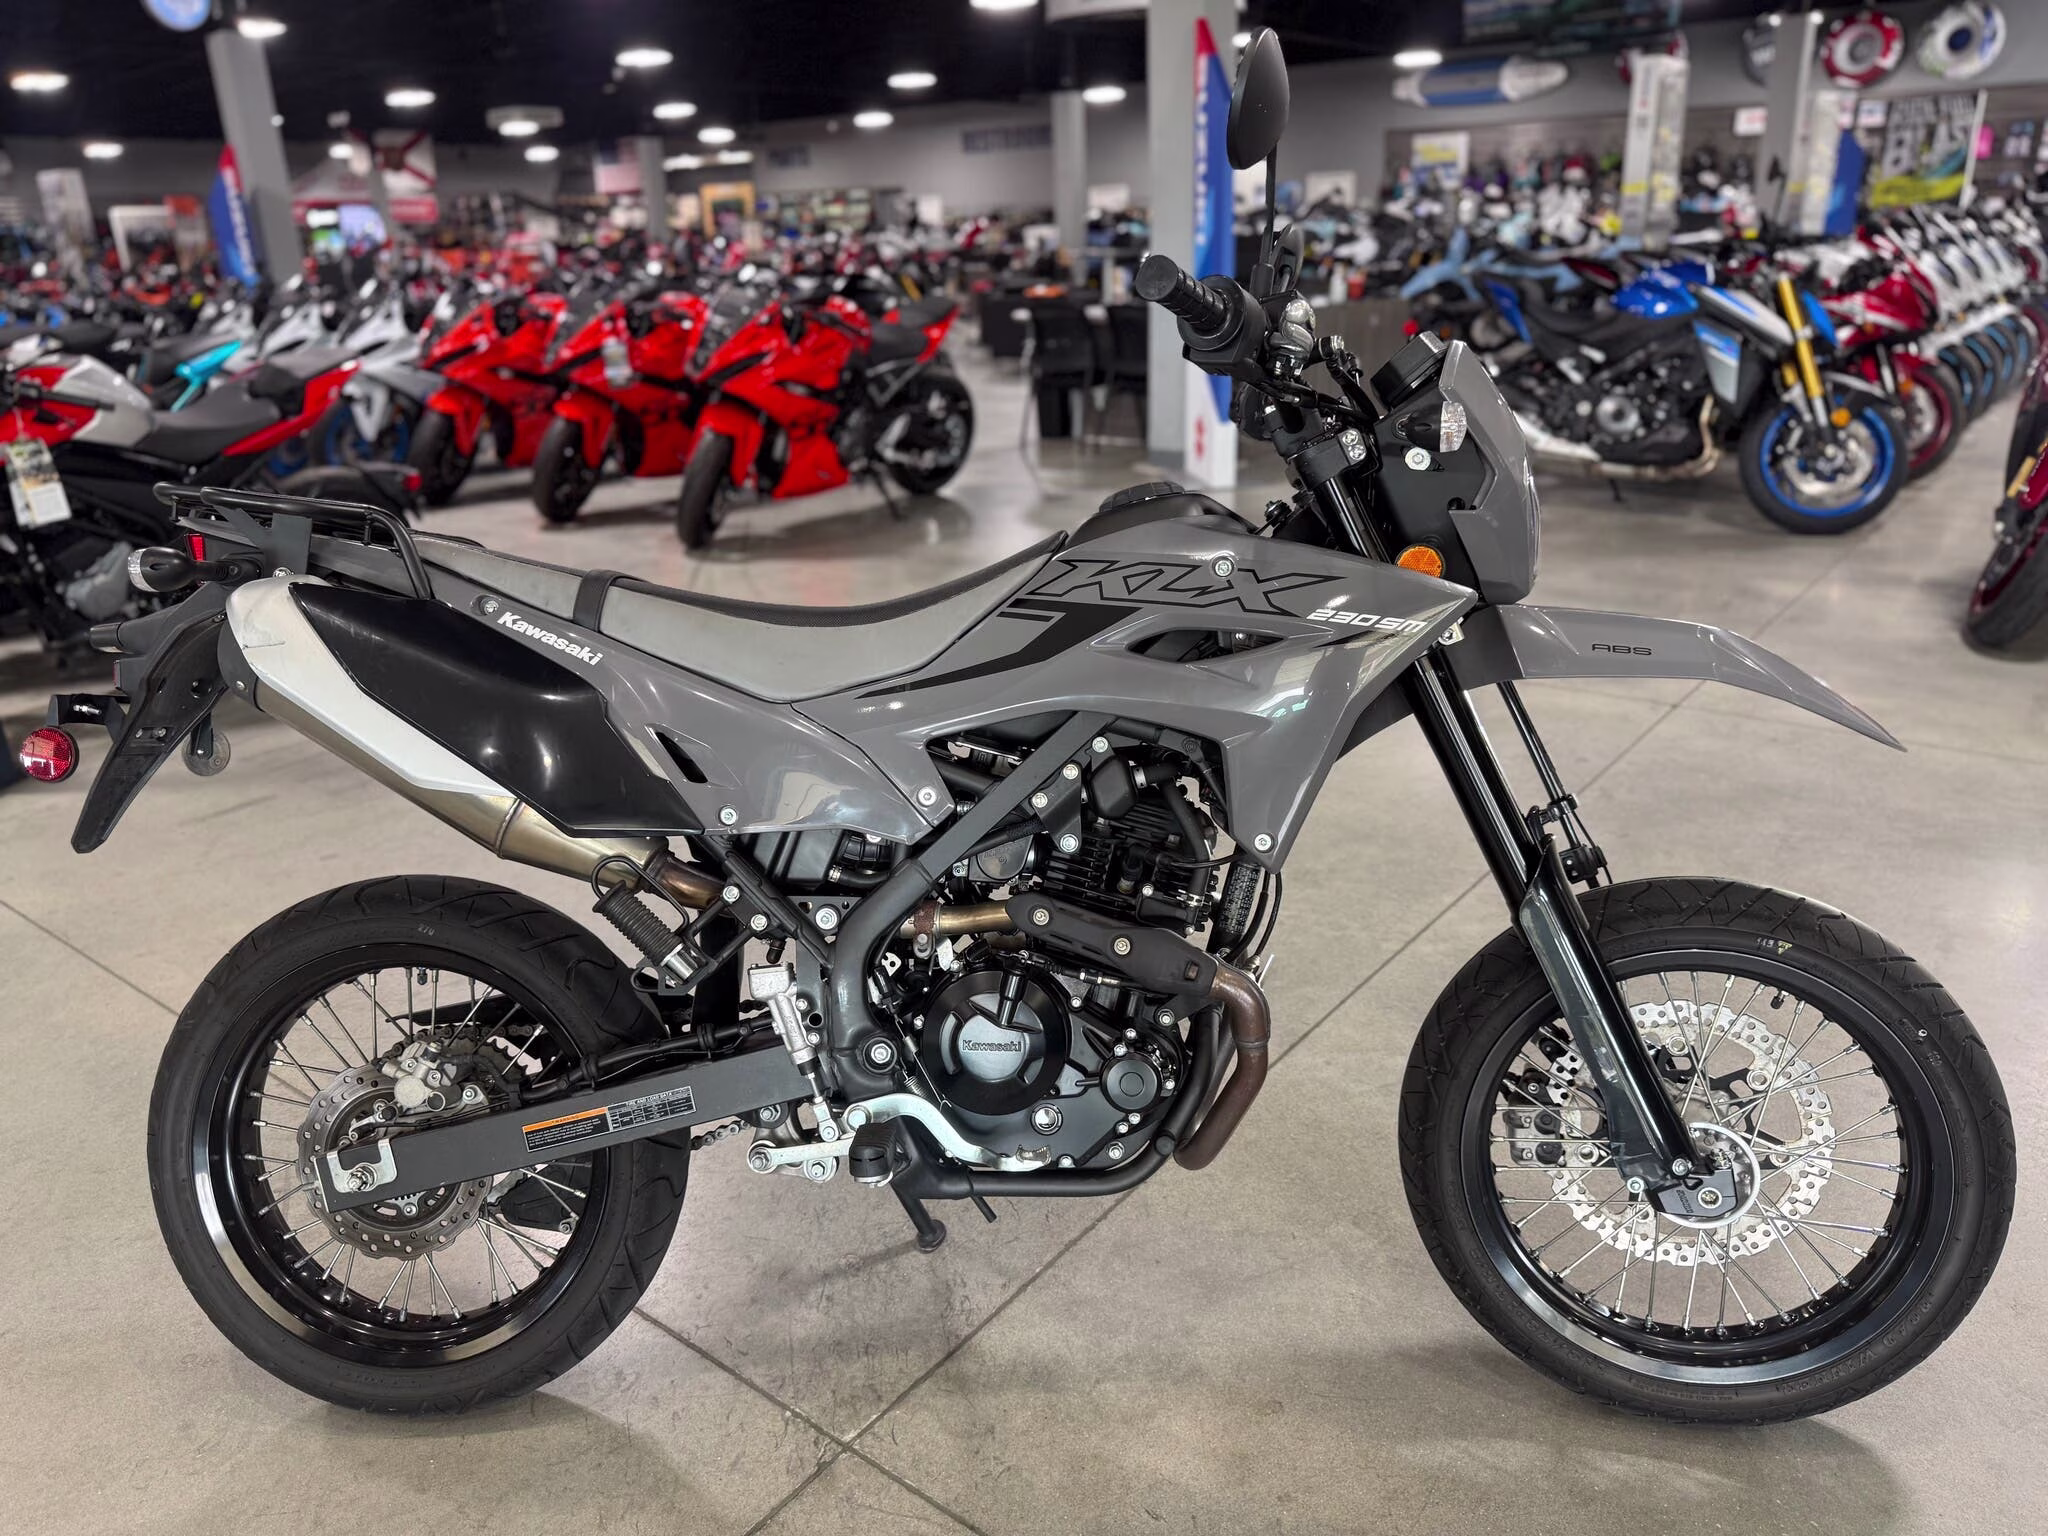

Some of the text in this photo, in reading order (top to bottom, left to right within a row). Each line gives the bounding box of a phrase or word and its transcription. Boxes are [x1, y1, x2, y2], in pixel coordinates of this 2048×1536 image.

[1027, 558, 1349, 618] KLX
[1306, 608, 1429, 634] 230SM
[496, 611, 604, 666] Kawasaki
[1591, 643, 1652, 656] ABS
[962, 1039, 1022, 1052] Kawasaki
